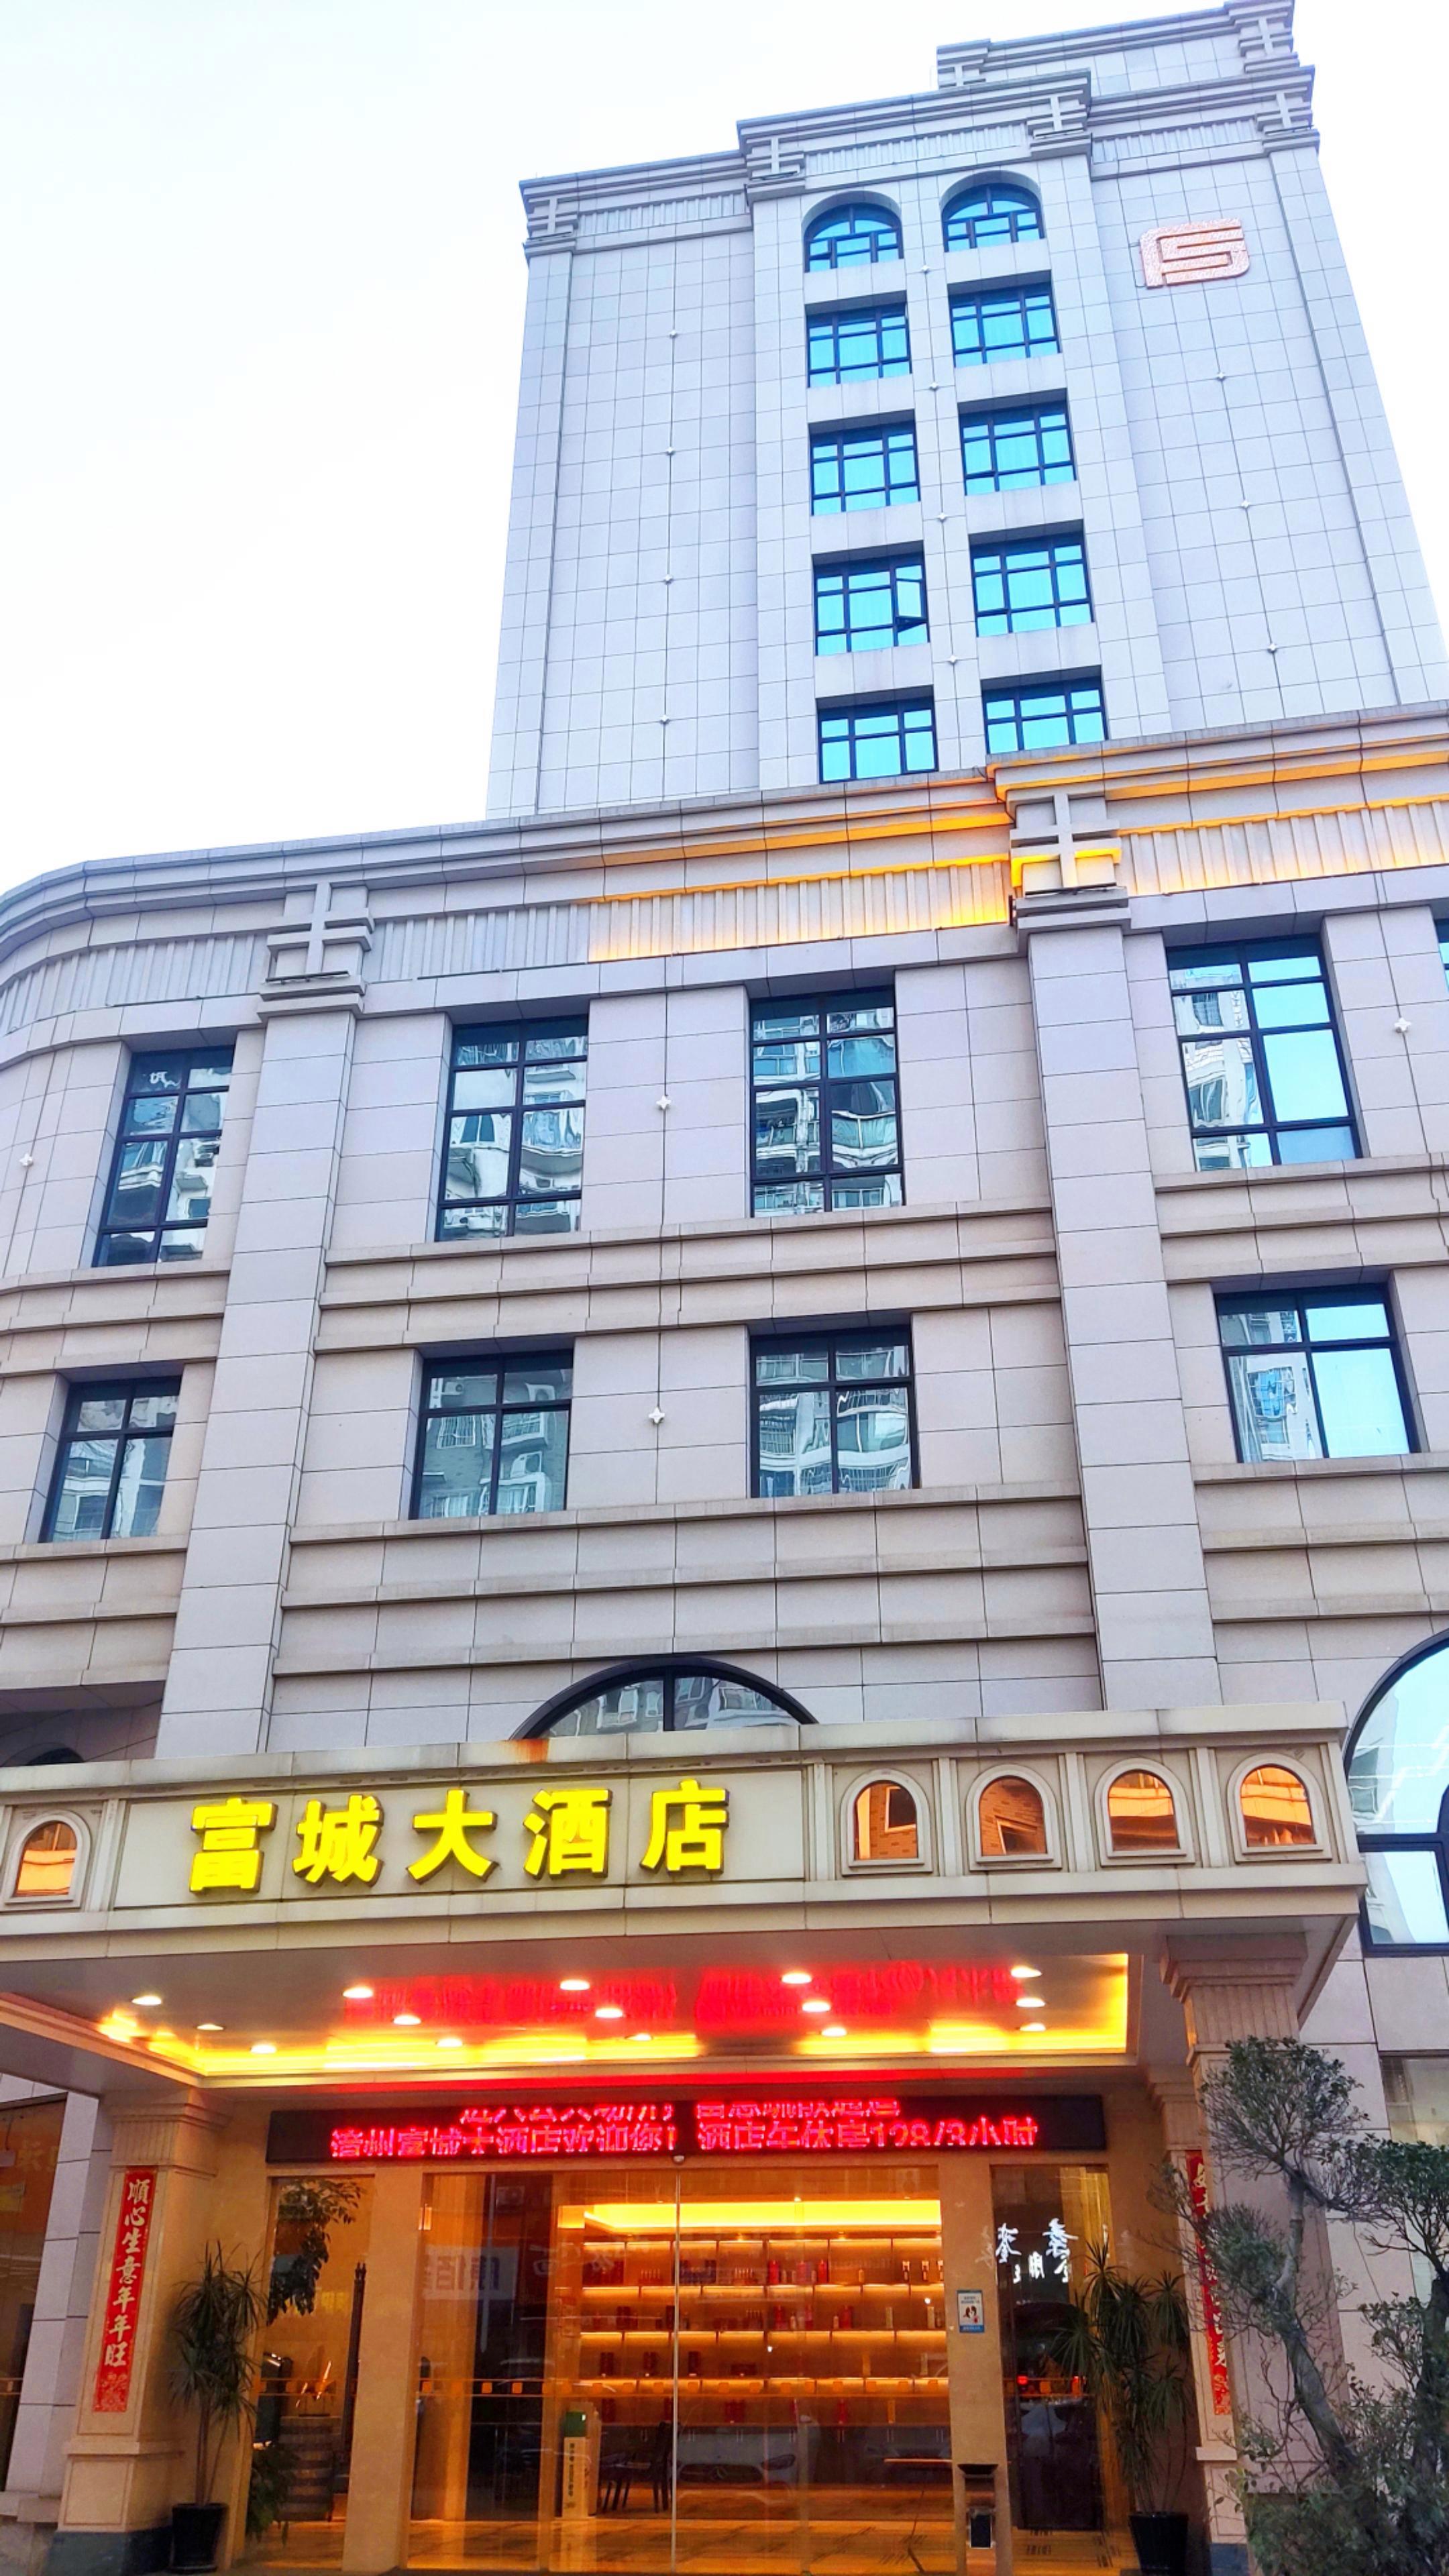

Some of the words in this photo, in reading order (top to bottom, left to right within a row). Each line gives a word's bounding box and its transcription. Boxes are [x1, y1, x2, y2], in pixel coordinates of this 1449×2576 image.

[189, 1778, 729, 1894] 富城大酒店
[104, 2179, 151, 2367] 順心生意年年旺
